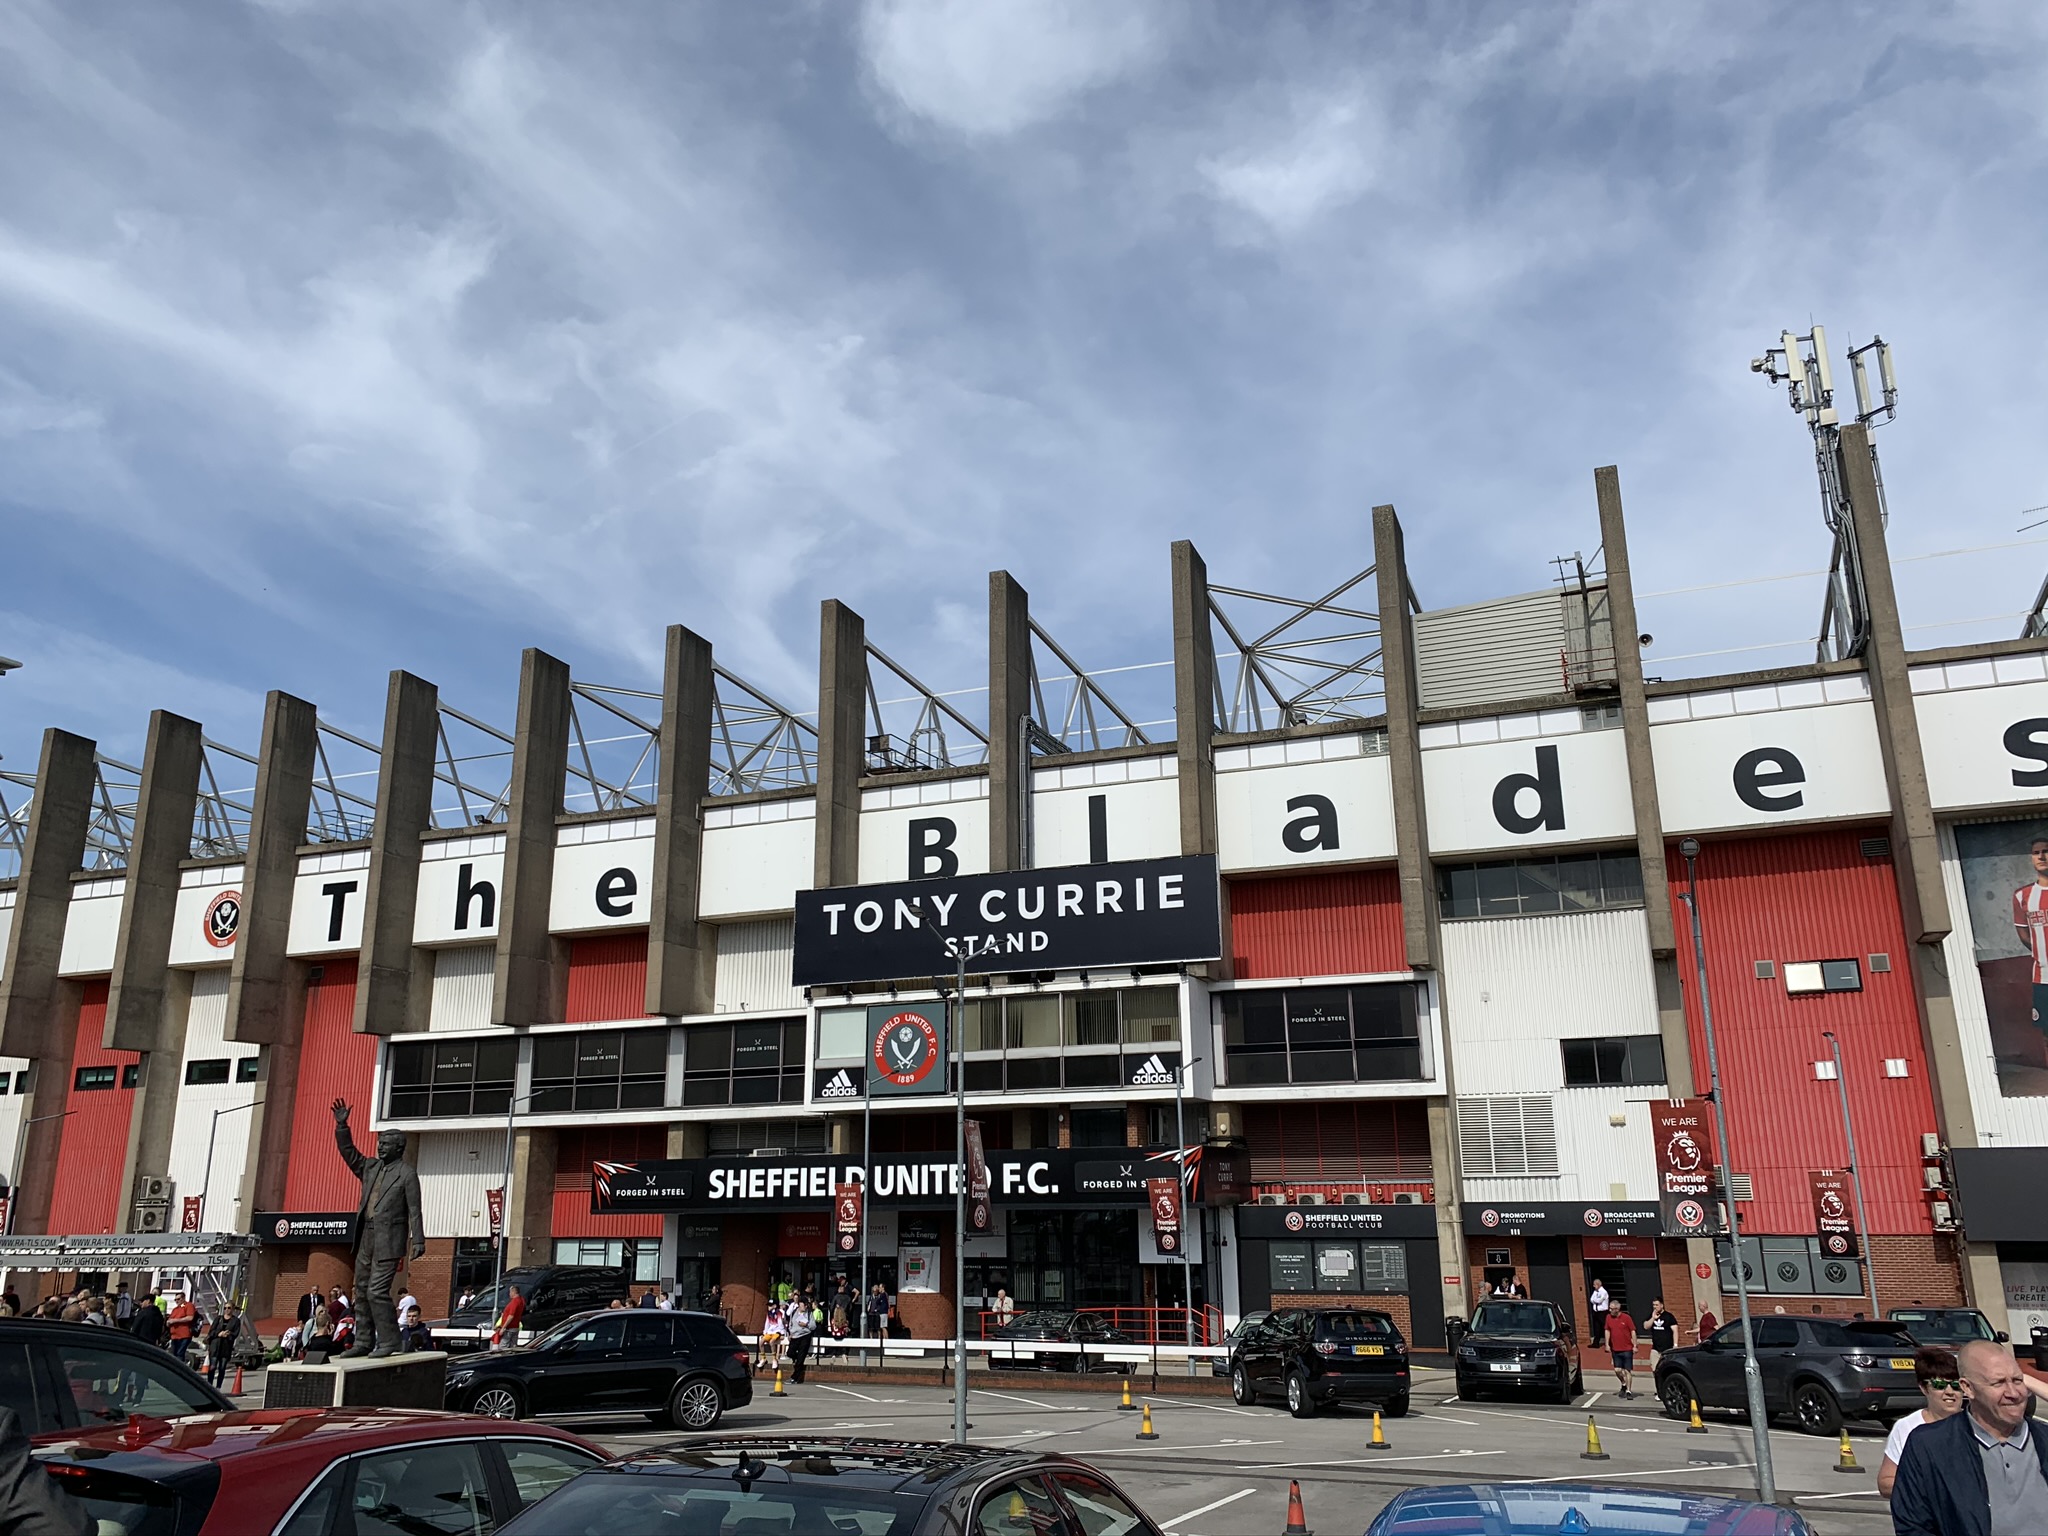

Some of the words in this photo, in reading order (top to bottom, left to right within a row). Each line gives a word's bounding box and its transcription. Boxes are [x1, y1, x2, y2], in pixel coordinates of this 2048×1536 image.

[822, 893, 959, 936] TONY
[979, 874, 1184, 923] CURRIE
[944, 930, 1050, 958] STAND
[875, 1016, 901, 1058] SHEFFIELD
[904, 1013, 932, 1035] UNITED
[897, 1074, 914, 1084] 1889
[1132, 1072, 1173, 1084] adidas
[822, 1086, 857, 1097] adidas
[1662, 1118, 1677, 1126] WE
[1678, 1117, 1698, 1126] ARE
[708, 1165, 866, 1199] SHEFFIELD
[873, 1163, 992, 1195] UNITE
[1002, 1161, 1059, 1194] F.C.
[1665, 1172, 1707, 1182] Premier
[1083, 1180, 1122, 1188] FORGED
[1126, 1180, 1138, 1188] IN
[1666, 1182, 1708, 1195] League
[616, 1188, 648, 1197] FORGED
[650, 1188, 659, 1196] IN
[661, 1188, 686, 1196] STEEL
[1305, 1214, 1349, 1222] SHEFFIELD
[1820, 1218, 1848, 1226] Premier
[290, 1221, 323, 1229] SHEFFIELD
[0, 1239, 57, 1248] WW.RA-TLS.COM
[70, 1238, 136, 1247] WWW.RA-TLS.COM
[55, 1257, 73, 1266] TURF
[74, 1257, 107, 1266] LIGHTING
[108, 1256, 149, 1266] SOLUTIONS
